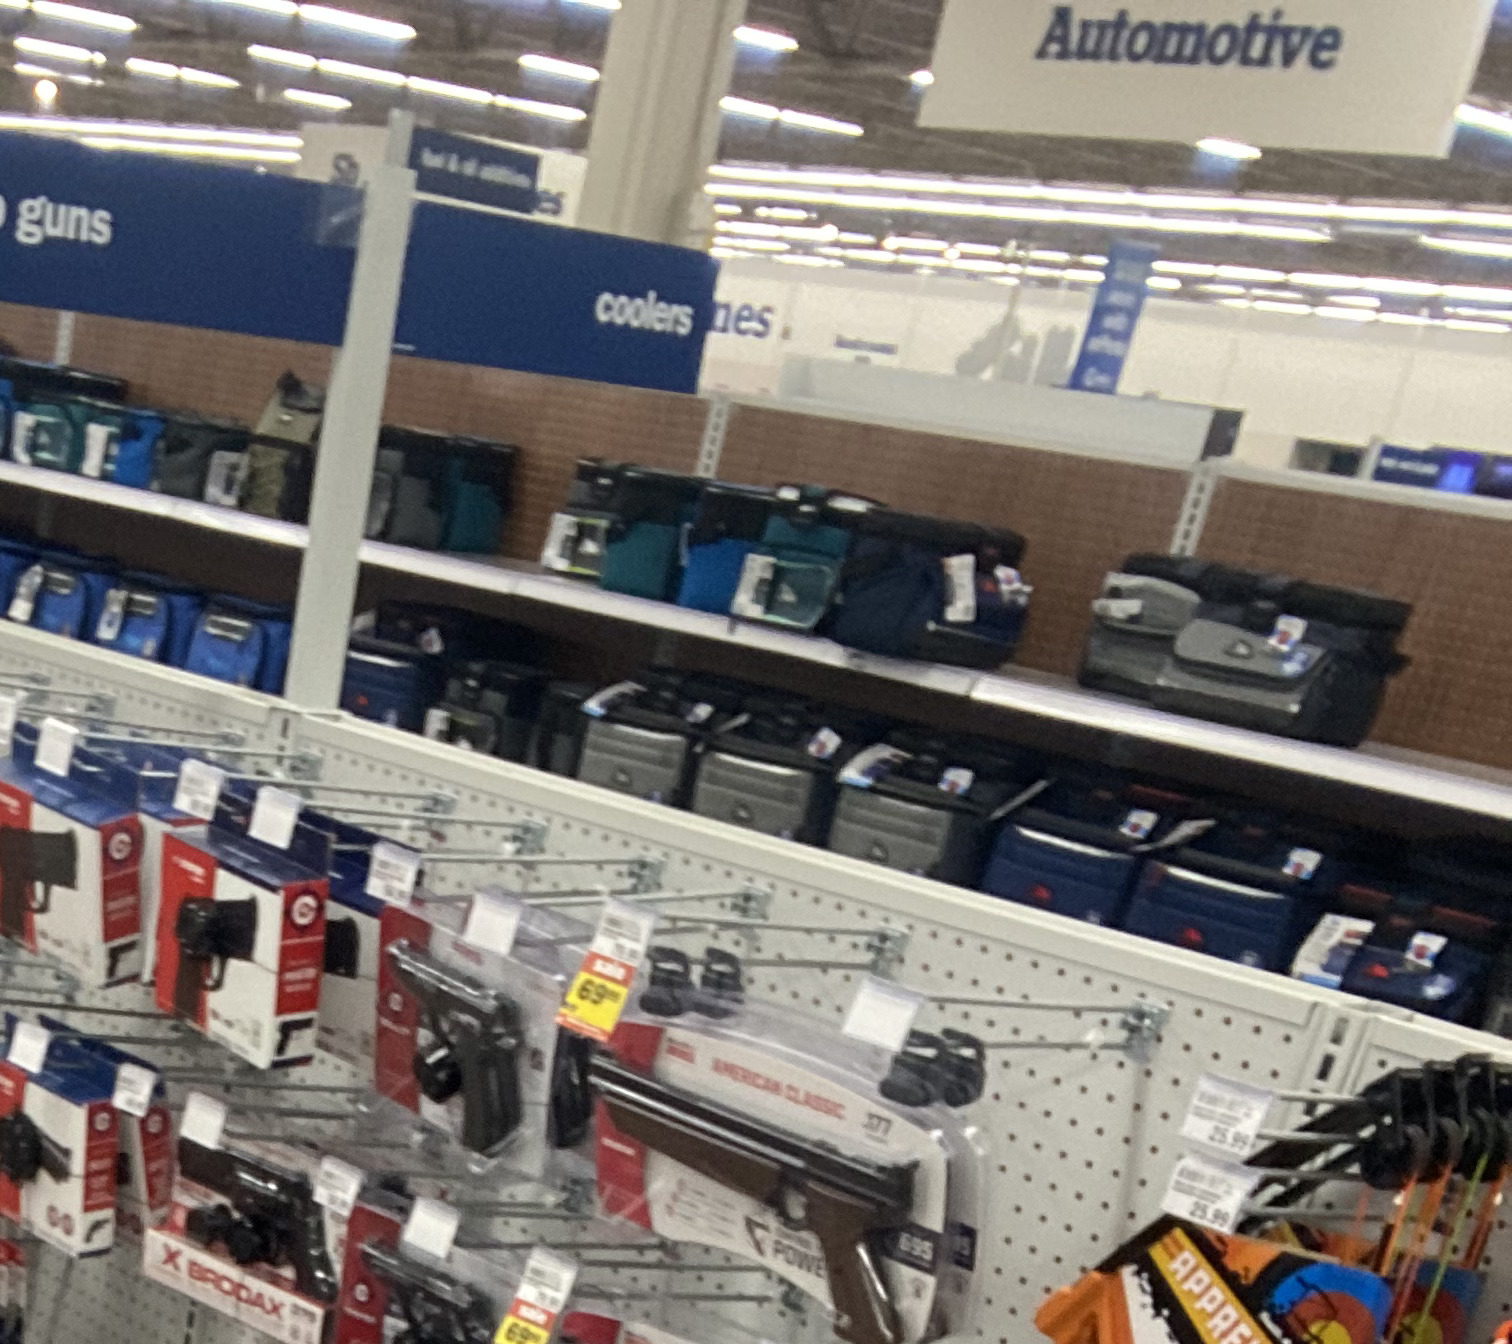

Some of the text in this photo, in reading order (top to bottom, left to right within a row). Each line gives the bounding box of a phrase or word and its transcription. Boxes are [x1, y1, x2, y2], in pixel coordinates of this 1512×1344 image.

[1036, 6, 1344, 70] Automotive
[16, 195, 112, 246] guns
[595, 287, 694, 337] coolers
[1189, 1200, 1230, 1227] 25.99
[187, 1258, 285, 1320] BRODAX
